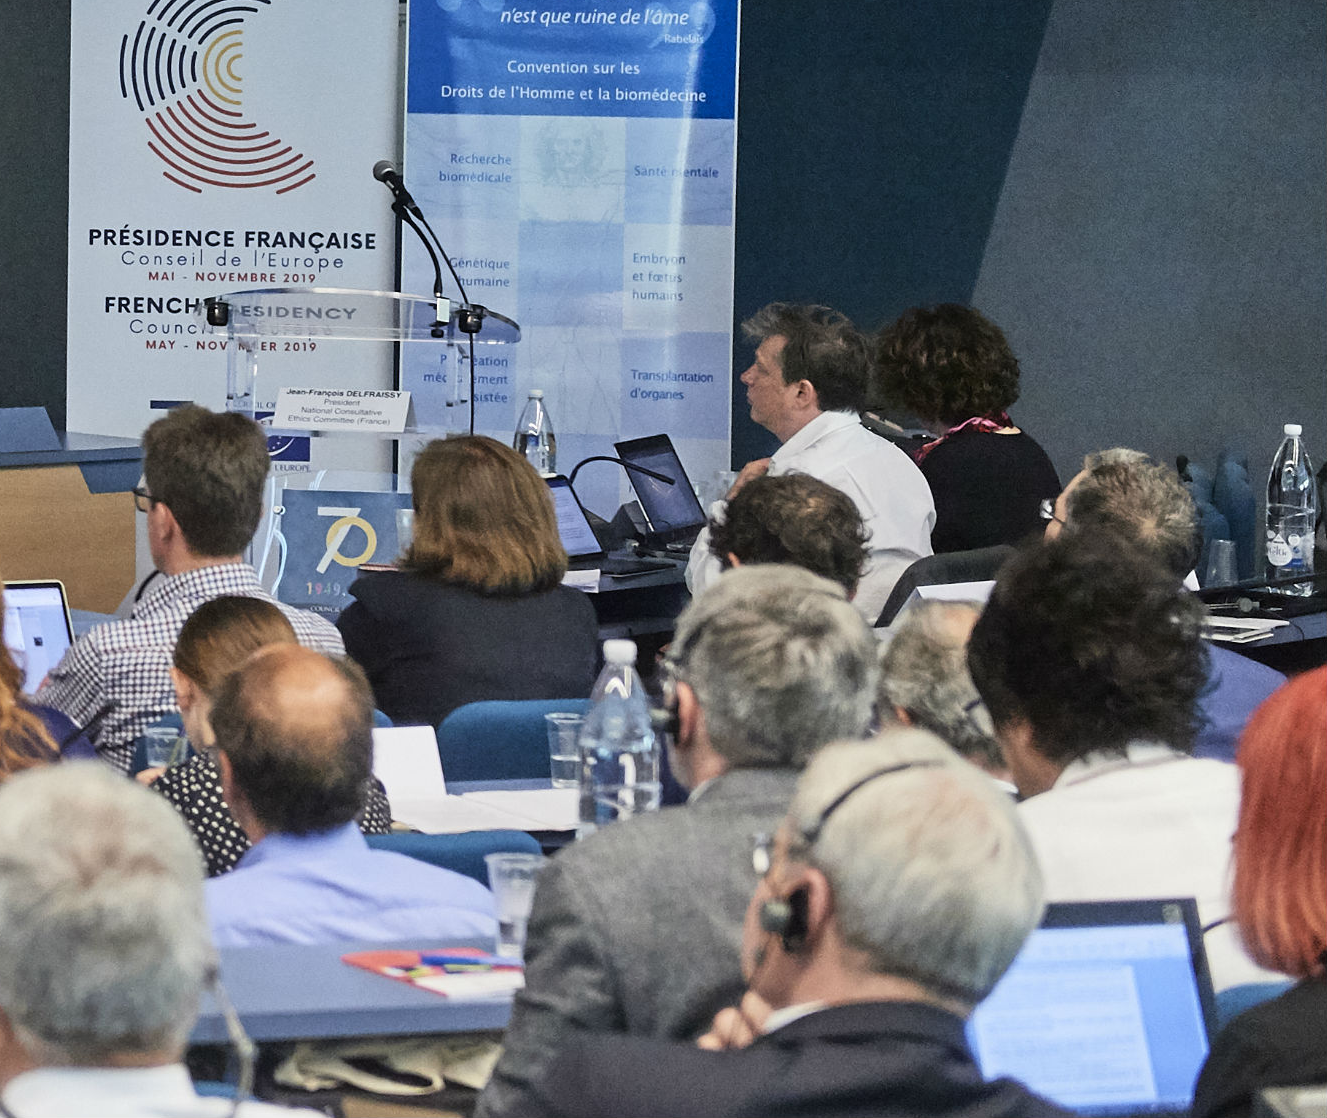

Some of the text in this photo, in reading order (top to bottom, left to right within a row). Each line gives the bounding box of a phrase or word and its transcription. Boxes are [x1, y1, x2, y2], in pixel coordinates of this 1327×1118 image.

[500, 8, 689, 27] n'est que ruine de l'âme
[663, 33, 705, 45] Rabelais
[507, 60, 641, 75] Convention sur les
[440, 85, 707, 102] Droits de l'Homme et la biomédecine
[450, 153, 512, 166] Recherche
[439, 170, 512, 183] biomédicale
[633, 164, 667, 178] Santé
[88, 224, 377, 254] PRÉSIDENCE FRANÇAISE
[121, 249, 345, 273] Conseil de l'Europe
[449, 257, 511, 270] Génétique
[632, 252, 686, 266] Embryon
[148, 271, 176, 282] MAI
[195, 271, 277, 283] NOVEMBRE
[283, 273, 316, 284] 2019
[457, 276, 511, 288] humaine
[632, 272, 645, 283] et
[632, 289, 684, 302] humains
[104, 296, 358, 320] FRENCH ESIDENCY
[145, 340, 176, 350] MAY
[284, 341, 317, 352] 2019
[631, 369, 714, 383] Transplantation
[286, 388, 402, 399] Jean-François DELFRAISSY
[630, 387, 685, 400] d'organes
[300, 406, 333, 414] National
[313, 416, 355, 424] Committee
[356, 417, 391, 426] (France)
